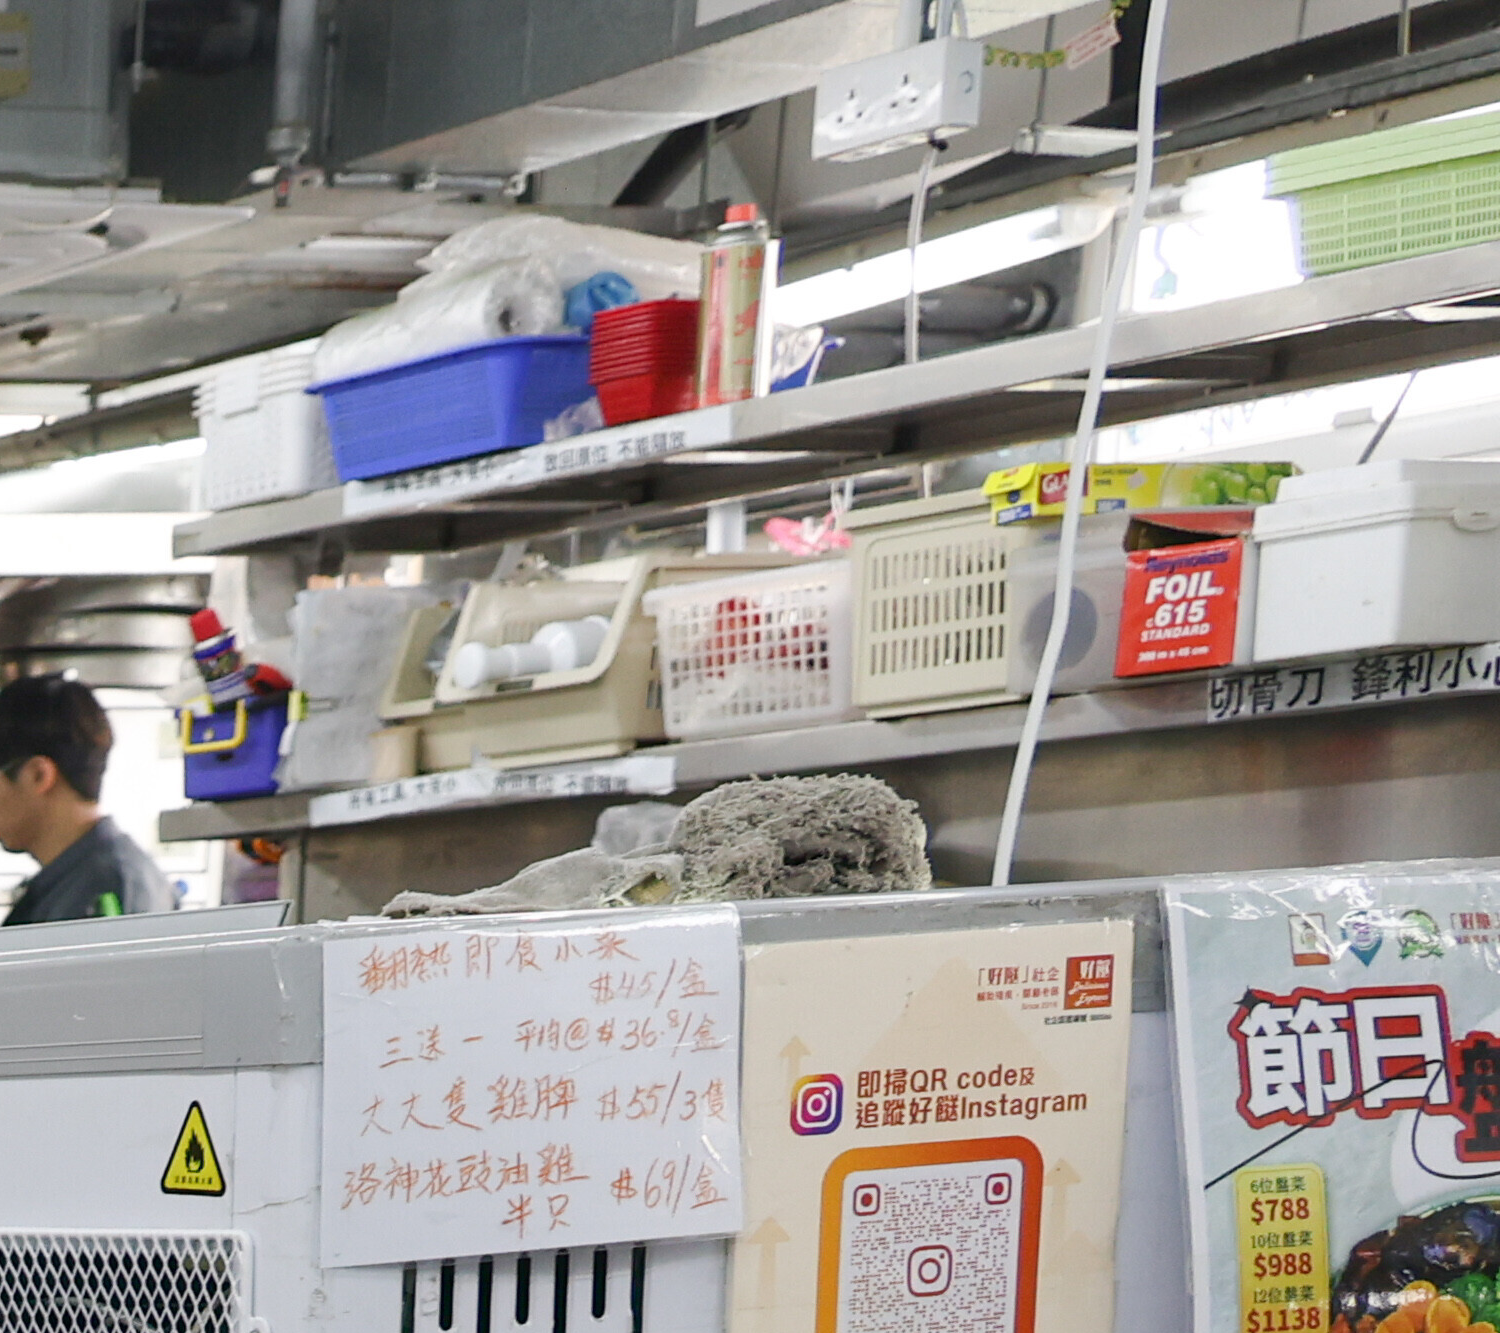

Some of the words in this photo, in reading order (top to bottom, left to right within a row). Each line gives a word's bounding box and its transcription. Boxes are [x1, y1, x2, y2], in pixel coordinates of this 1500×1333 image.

[1145, 571, 1220, 604] FOIL
[1140, 622, 1211, 643] STANDARD
[1209, 666, 1326, 718] 切骨刀
[1251, 1197, 1310, 1225] $788
[1254, 1252, 1313, 1280] $988
